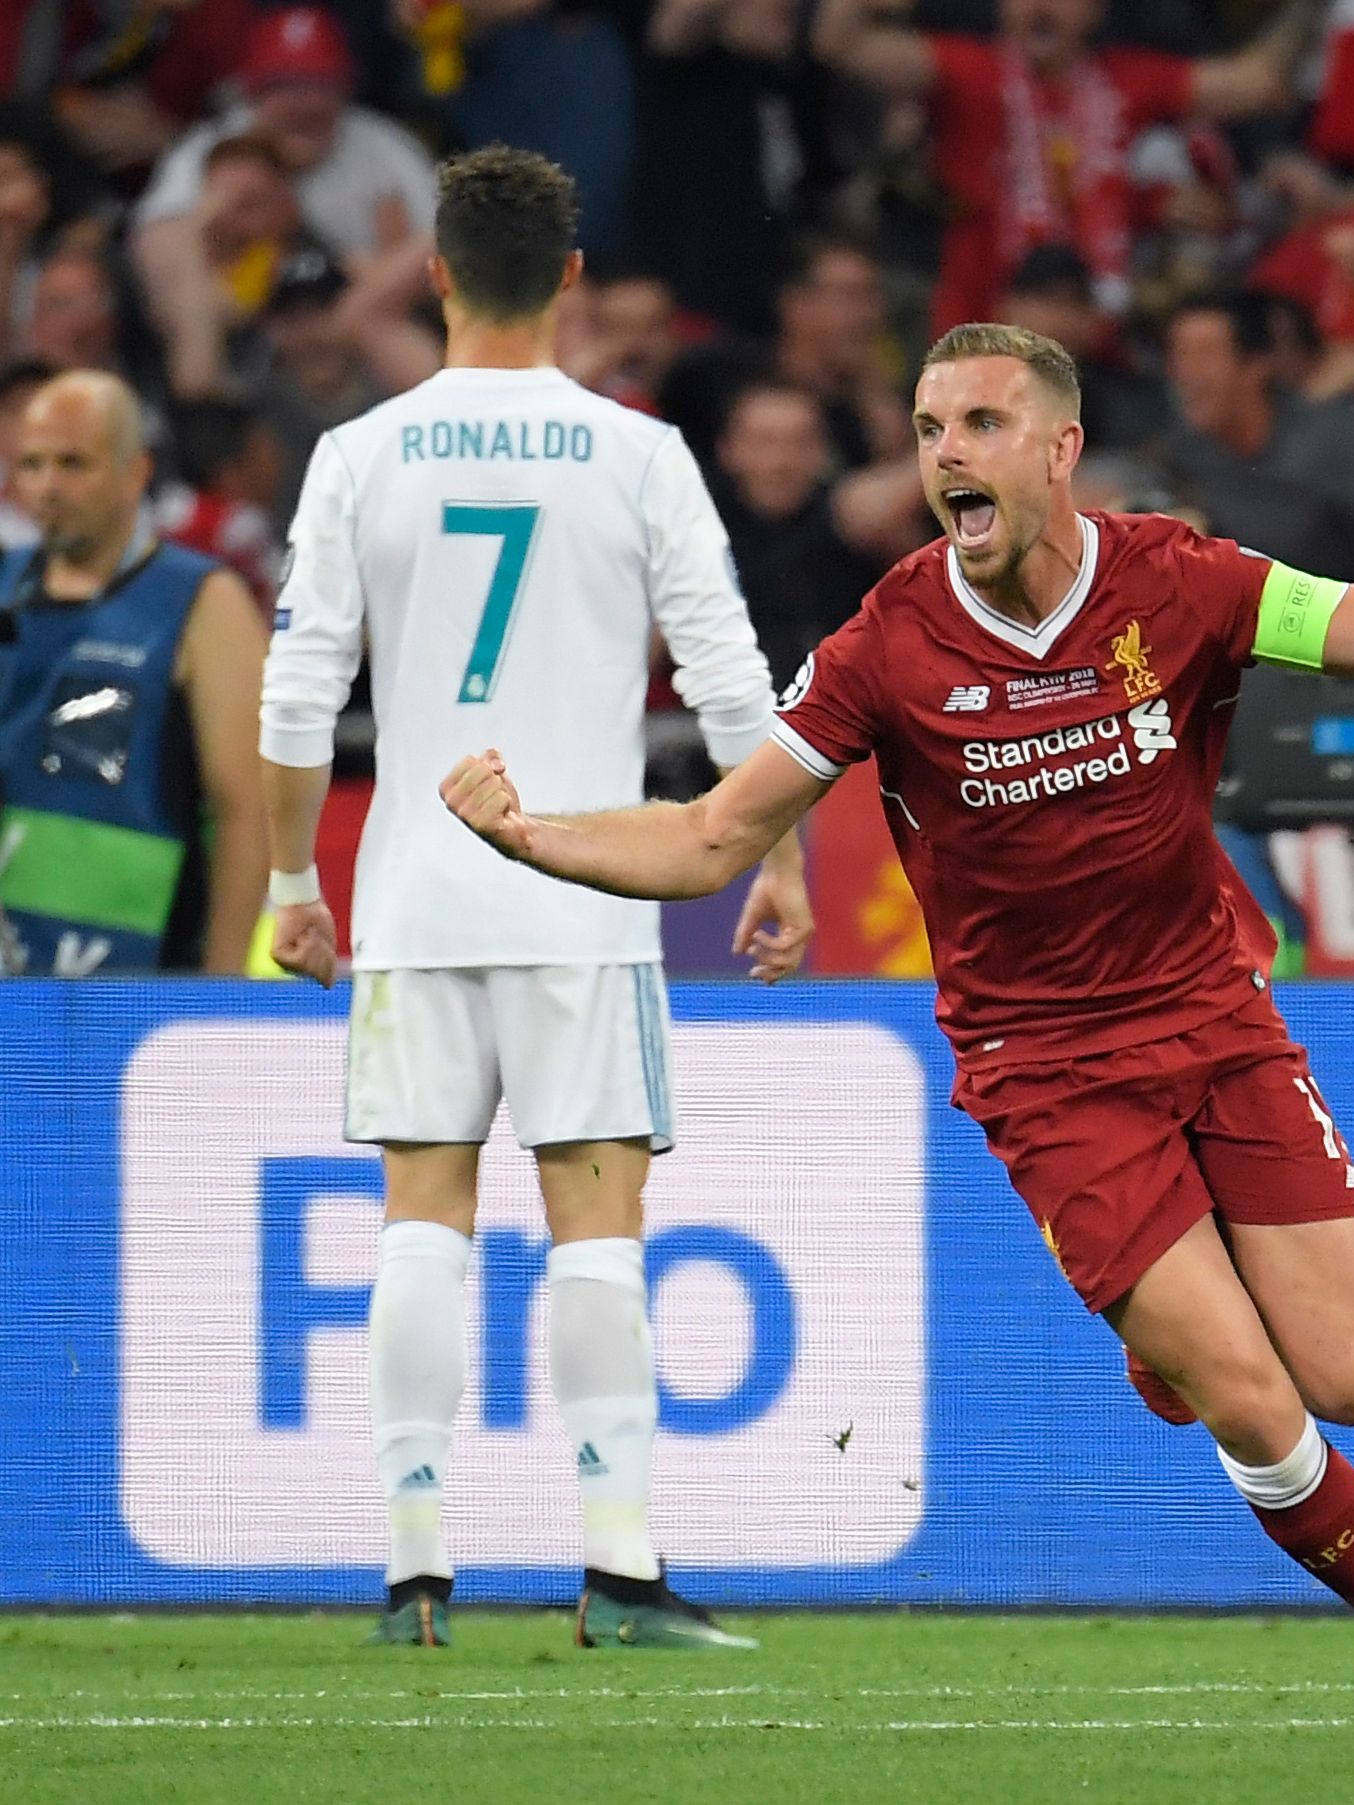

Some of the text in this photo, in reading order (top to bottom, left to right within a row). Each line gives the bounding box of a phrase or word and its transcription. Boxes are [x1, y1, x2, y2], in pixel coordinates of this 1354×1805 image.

[402, 421, 592, 463] RONALDO
[441, 500, 543, 703] 7
[1006, 678, 1040, 692] FINAL
[1040, 674, 1066, 687] KYIV
[1069, 667, 1095, 682] 2018
[1124, 672, 1160, 697] LFC
[963, 714, 1122, 773] Standard
[960, 742, 1132, 807] Chartered
